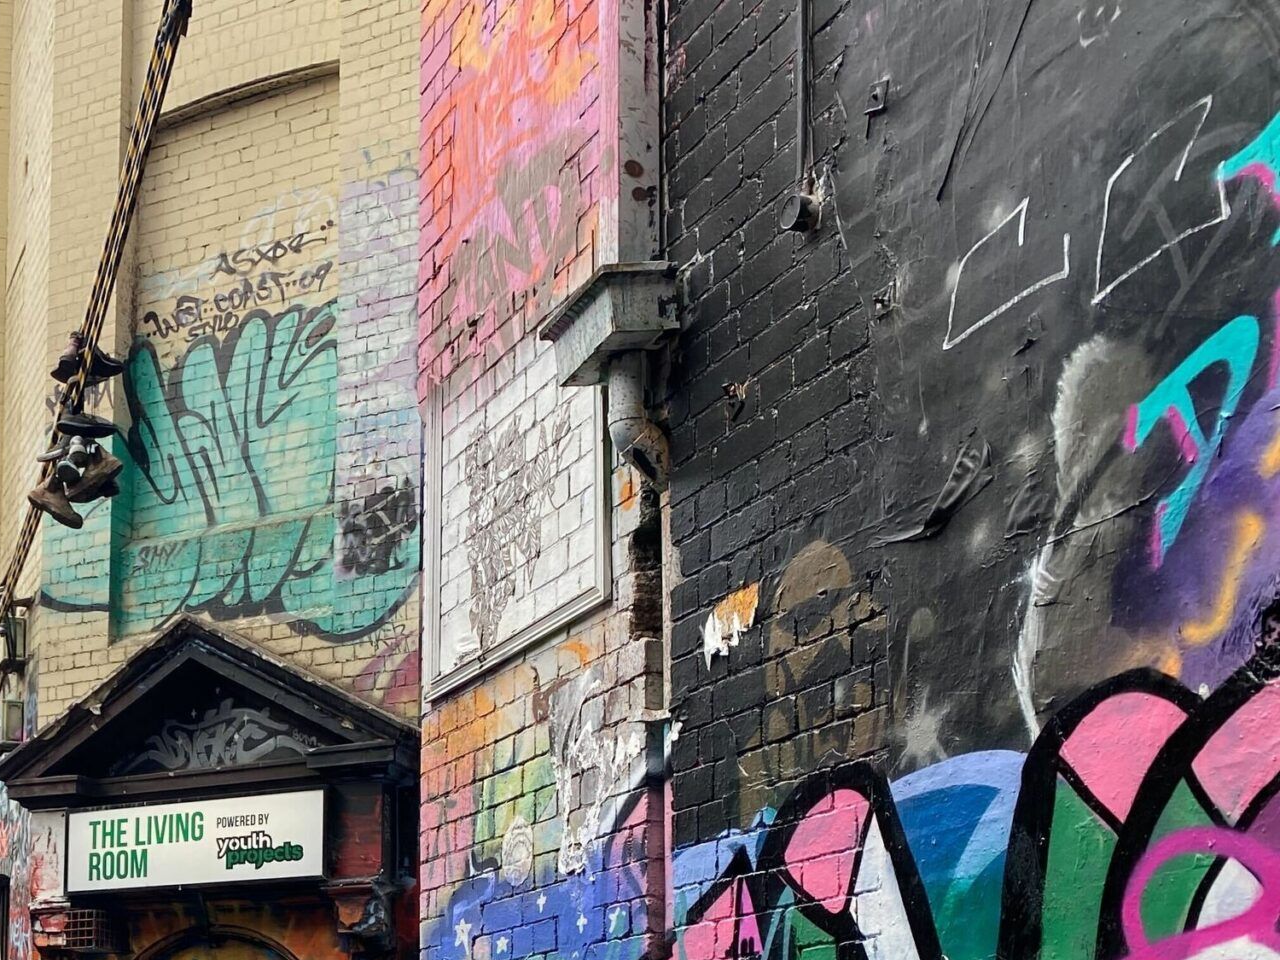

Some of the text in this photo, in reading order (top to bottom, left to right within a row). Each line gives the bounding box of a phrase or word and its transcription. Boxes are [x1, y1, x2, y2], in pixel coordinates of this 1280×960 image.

[89, 811, 204, 849] THE LIVING
[216, 813, 270, 829] POWERED BY
[217, 831, 272, 859] youth
[225, 842, 304, 870] projects
[88, 850, 148, 881] ROOM
